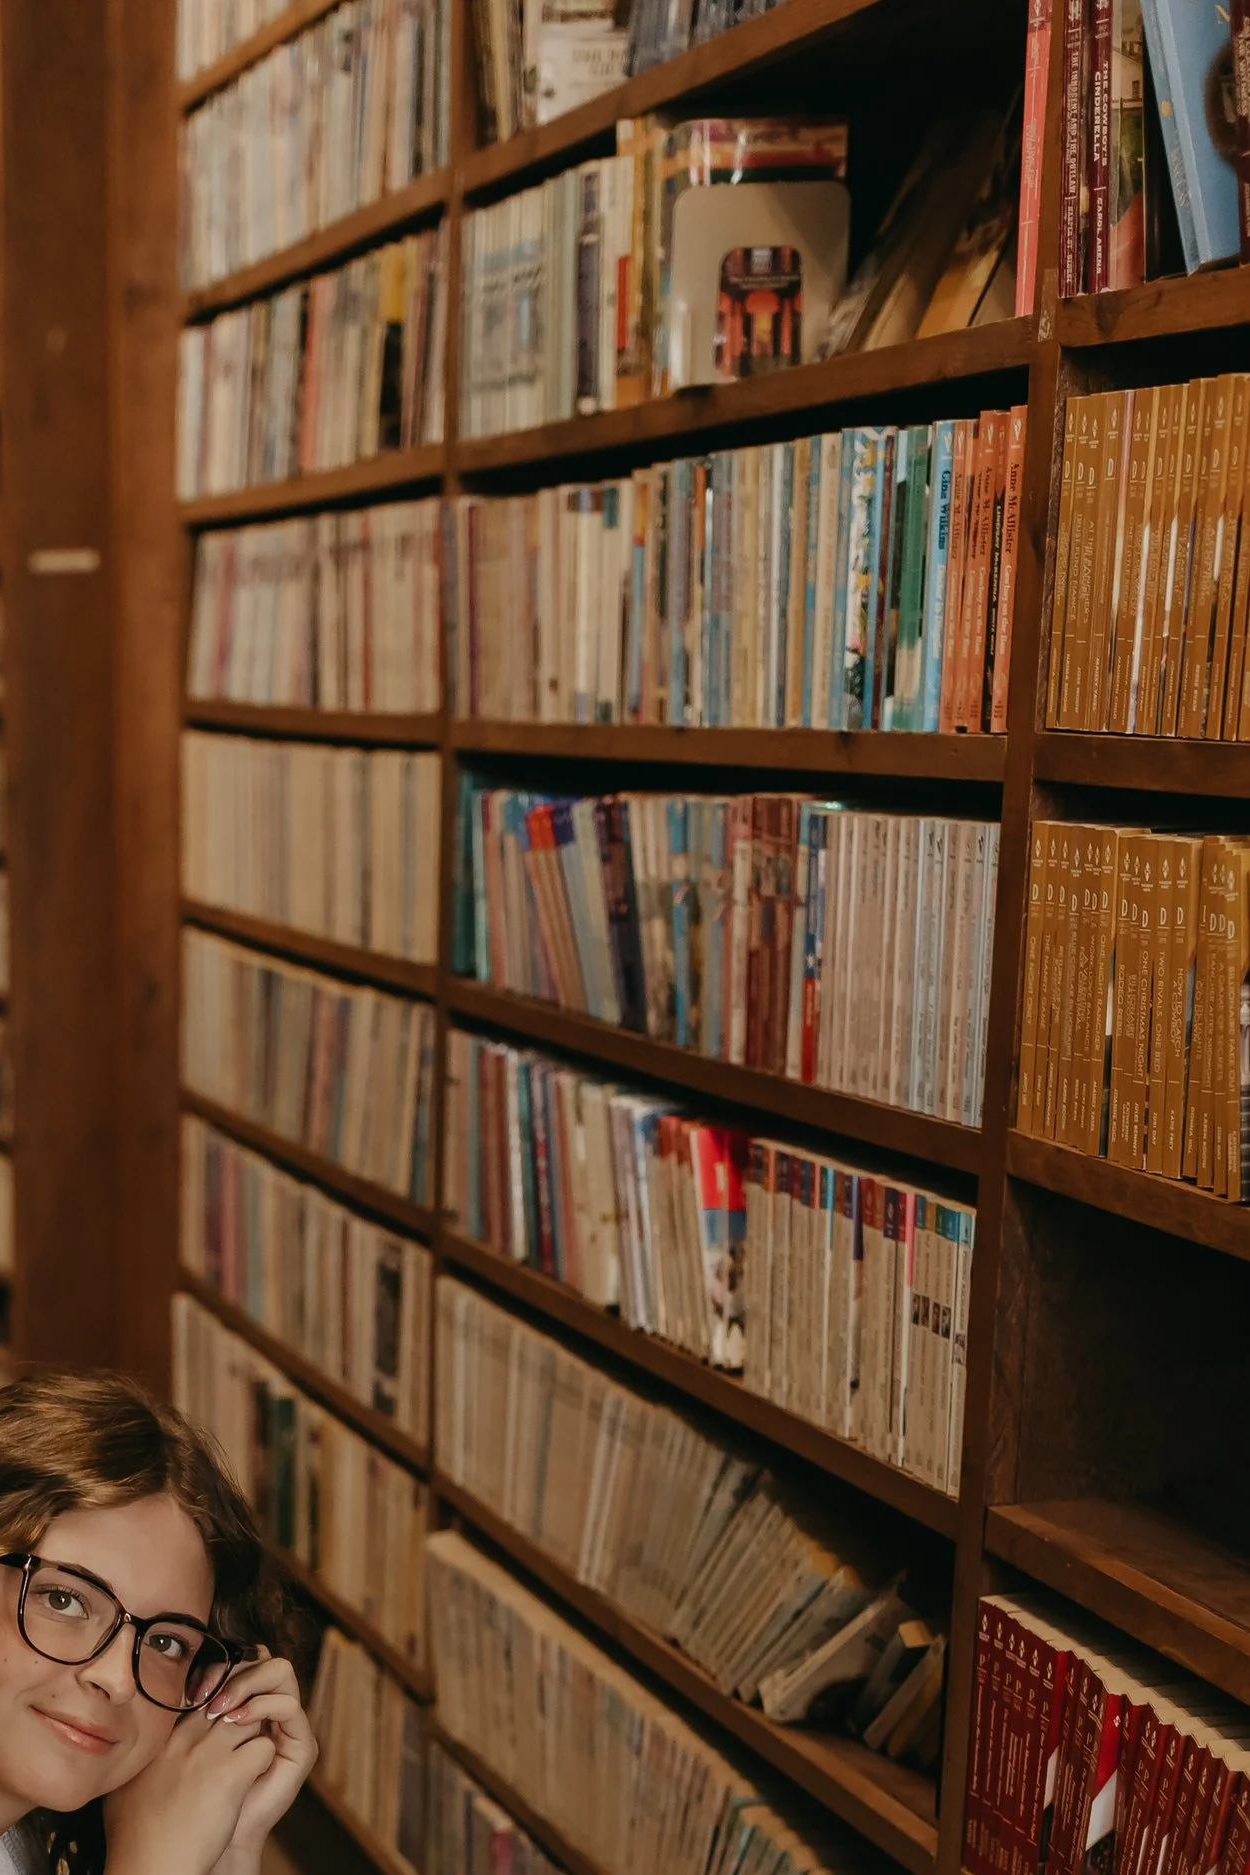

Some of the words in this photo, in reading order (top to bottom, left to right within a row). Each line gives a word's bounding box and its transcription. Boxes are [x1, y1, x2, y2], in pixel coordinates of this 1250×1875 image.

[940, 470, 952, 500] Gina
[1010, 462, 1020, 492] Anne
[938, 504, 949, 550] Wilkins
[1005, 495, 1018, 554] McAllister
[1094, 998, 1102, 1051] RANCHER
[1138, 980, 1148, 1041] CHRISTMAS
[1136, 1043, 1145, 1078] NIGHT
